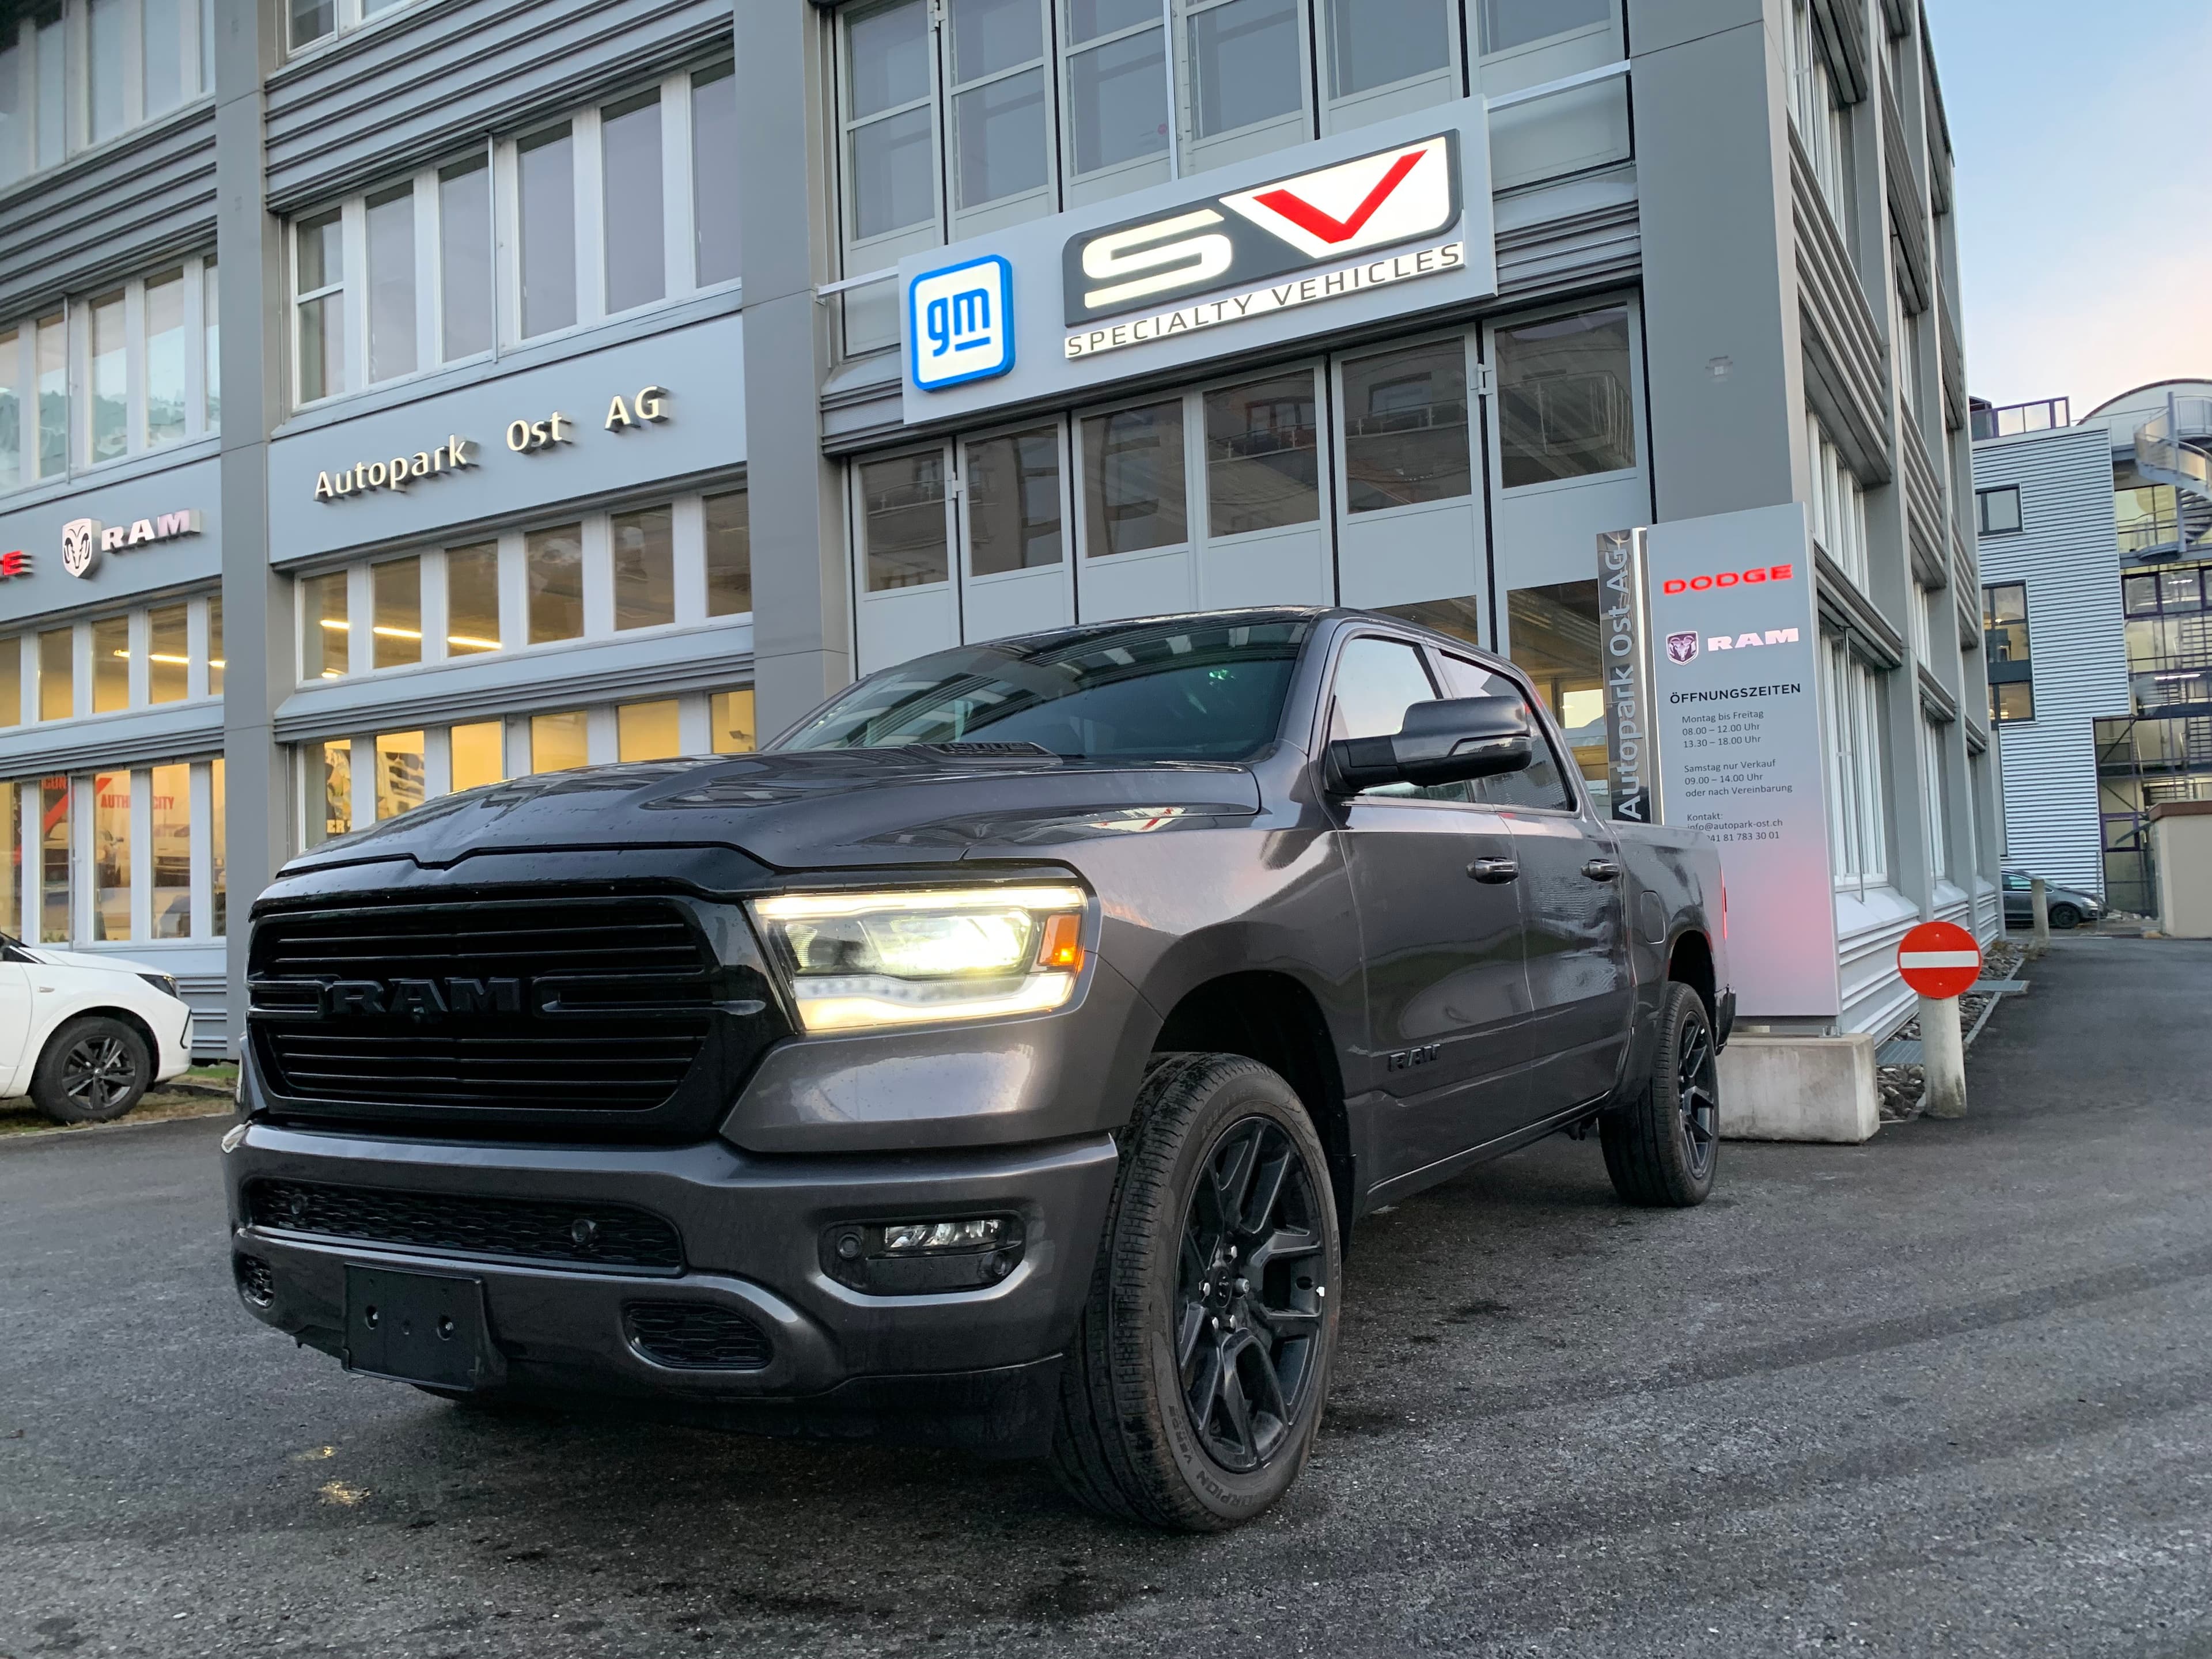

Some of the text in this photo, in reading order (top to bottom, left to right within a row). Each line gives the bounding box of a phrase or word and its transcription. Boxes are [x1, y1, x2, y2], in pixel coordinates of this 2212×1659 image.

[1067, 243, 1460, 357] SPECIALTY VEHICLES
[927, 288, 990, 357] gm
[315, 386, 668, 499] Autopark Ost AG
[101, 509, 190, 551] RAM
[1663, 564, 1793, 595] DODGE
[1707, 628, 1798, 652] RAM
[1604, 549, 1644, 820] Autopark Ost AG
[1670, 683, 1801, 703] ÖFFNUNGSZEITEN
[1681, 711, 1764, 724] Montag bis Freitag
[1682, 726, 1707, 736] 08.00
[1717, 724, 1741, 733] 12.00
[1744, 722, 1760, 730] Uhr
[1684, 739, 1707, 748] 13.30
[1718, 736, 1743, 745] 18.00
[1745, 735, 1761, 743] Uhr
[1684, 764, 1721, 773] Samstag
[1740, 759, 1776, 768] Verkauf
[1684, 777, 1710, 785] 09.00
[1720, 774, 1744, 783] 14.00
[1747, 773, 1763, 781] Uhr
[1709, 787, 1728, 796] nach
[1732, 785, 1793, 795] Vereinbarung
[1687, 812, 1724, 821] Kontakt:
[1755, 832, 1766, 840] 30
[1768, 831, 1779, 839] 01
[333, 978, 521, 1013] RAM
